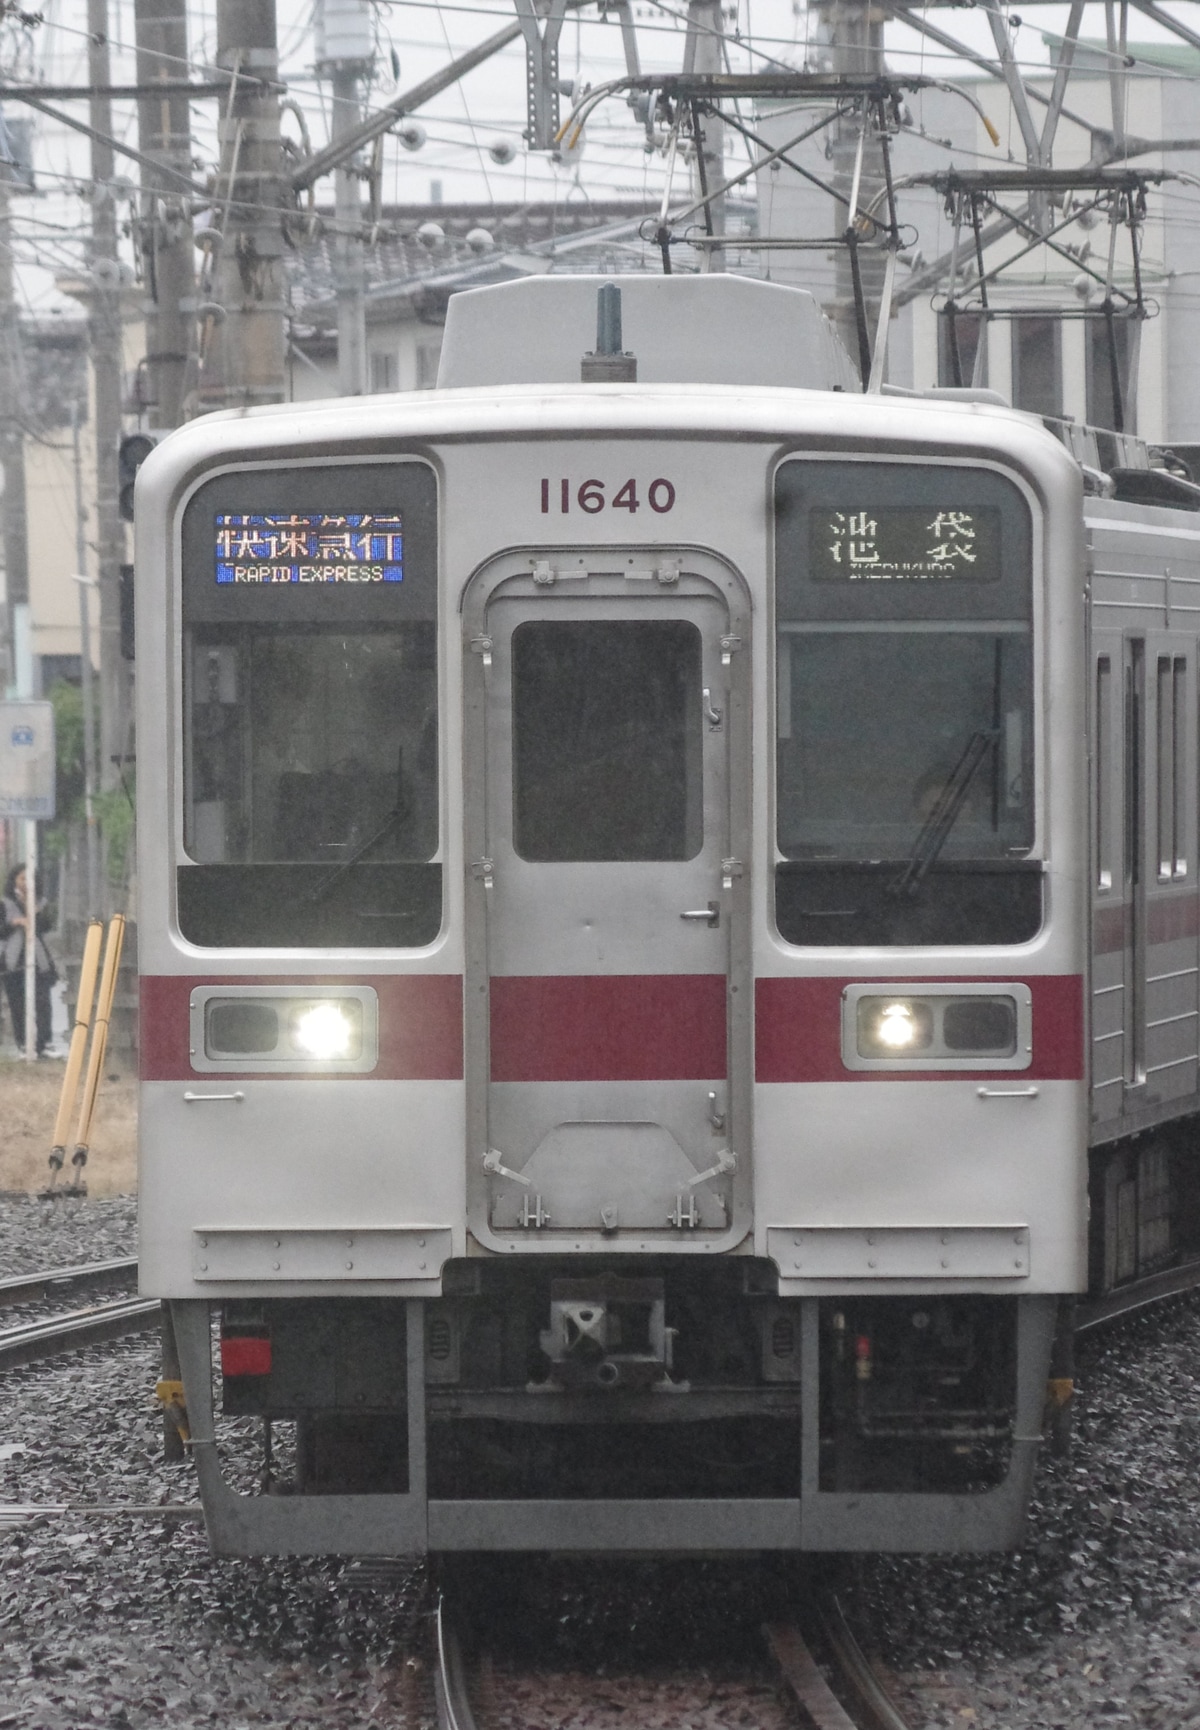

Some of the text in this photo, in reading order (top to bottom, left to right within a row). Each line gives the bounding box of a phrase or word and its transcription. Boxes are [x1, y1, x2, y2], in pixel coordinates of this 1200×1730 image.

[541, 478, 676, 514] 11640
[217, 515, 402, 561] 快速急行
[235, 566, 383, 582] RAPID EXPRESS
